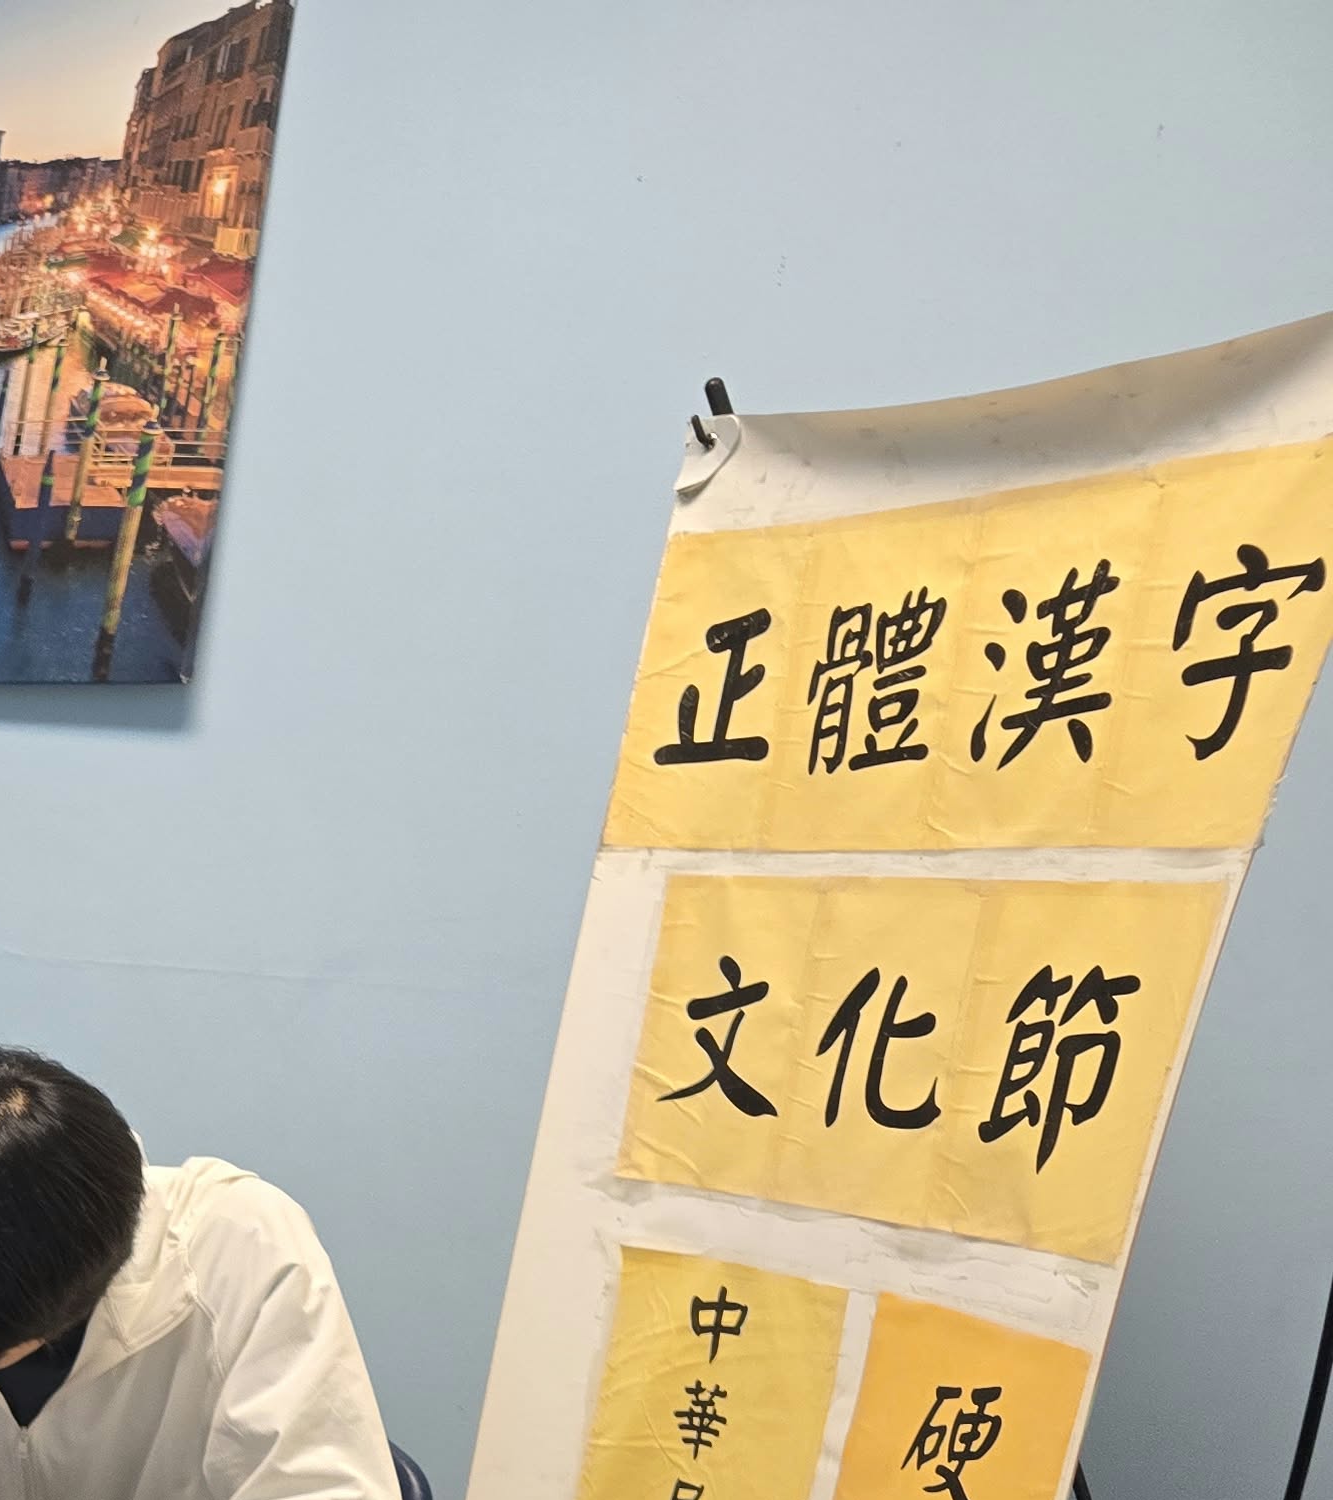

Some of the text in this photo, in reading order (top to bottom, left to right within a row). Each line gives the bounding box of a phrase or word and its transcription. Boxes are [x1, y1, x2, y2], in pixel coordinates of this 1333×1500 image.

[653, 544, 1326, 775] 正體漢字
[655, 955, 1141, 1175] 文化節
